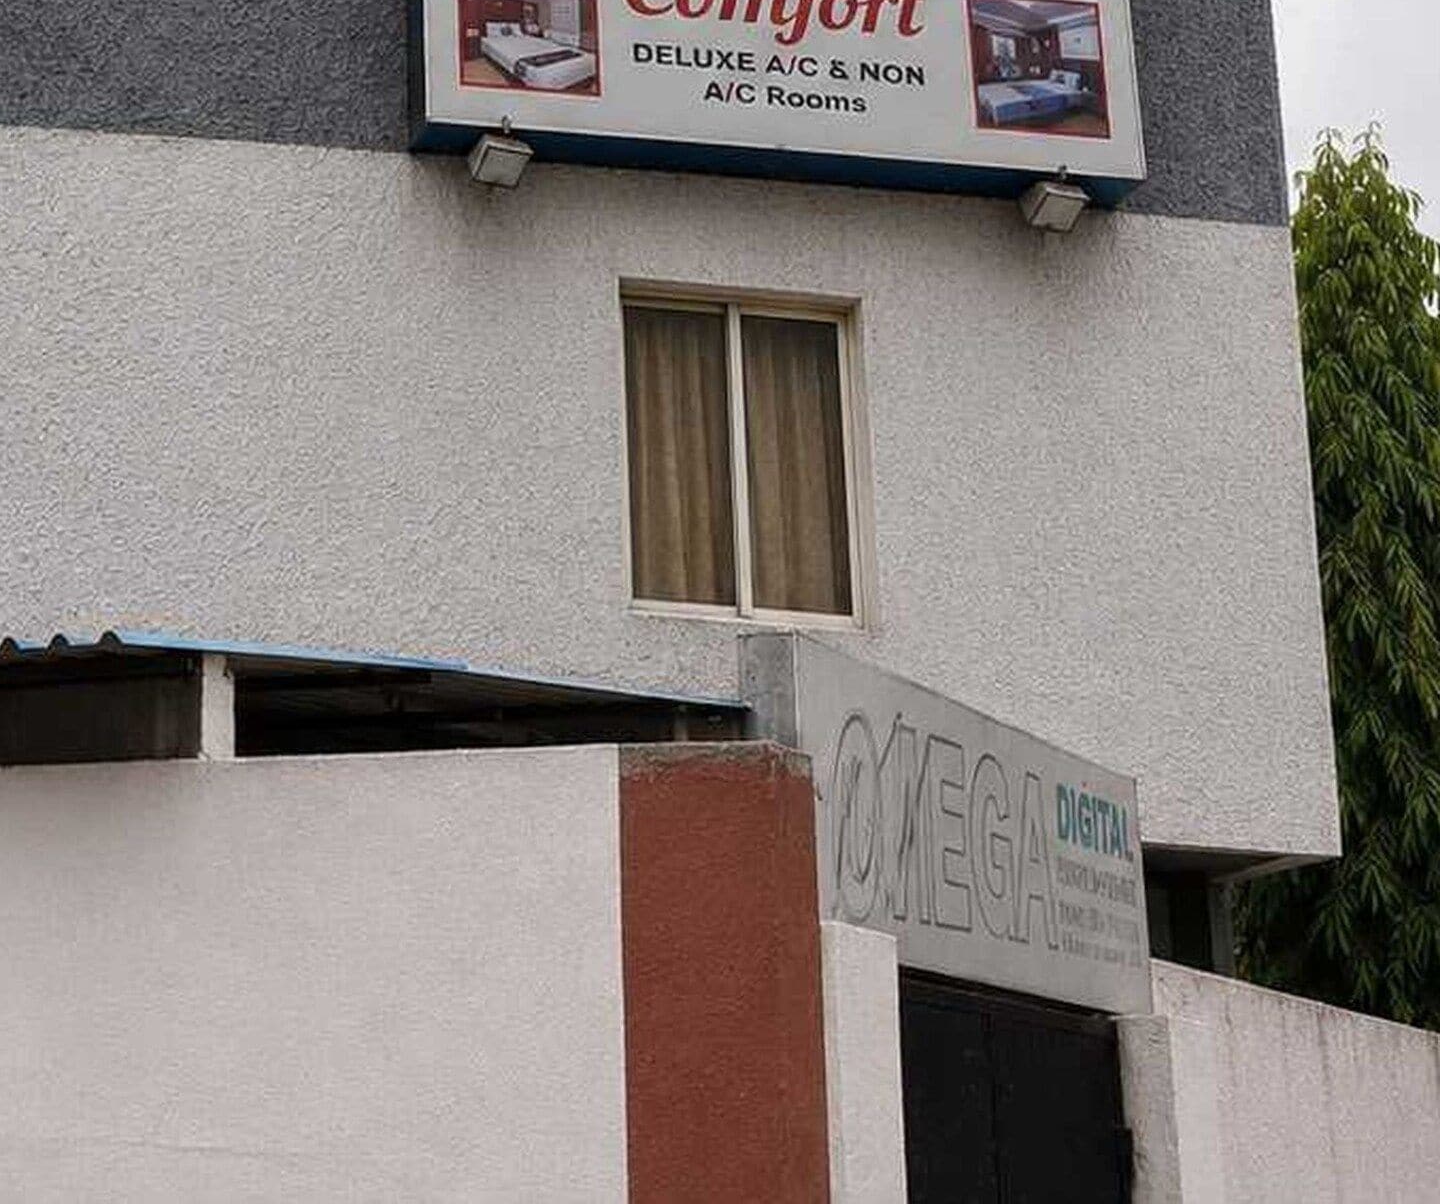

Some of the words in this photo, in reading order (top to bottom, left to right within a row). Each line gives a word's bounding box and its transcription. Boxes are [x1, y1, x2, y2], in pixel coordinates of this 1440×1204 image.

[632, 43, 756, 73] DELUXE
[765, 55, 818, 77] A/C
[828, 59, 850, 80] &
[860, 62, 926, 86] NON
[703, 82, 756, 103] A/C
[766, 85, 868, 113] Rooms
[1056, 781, 1134, 862] DIGITAL
